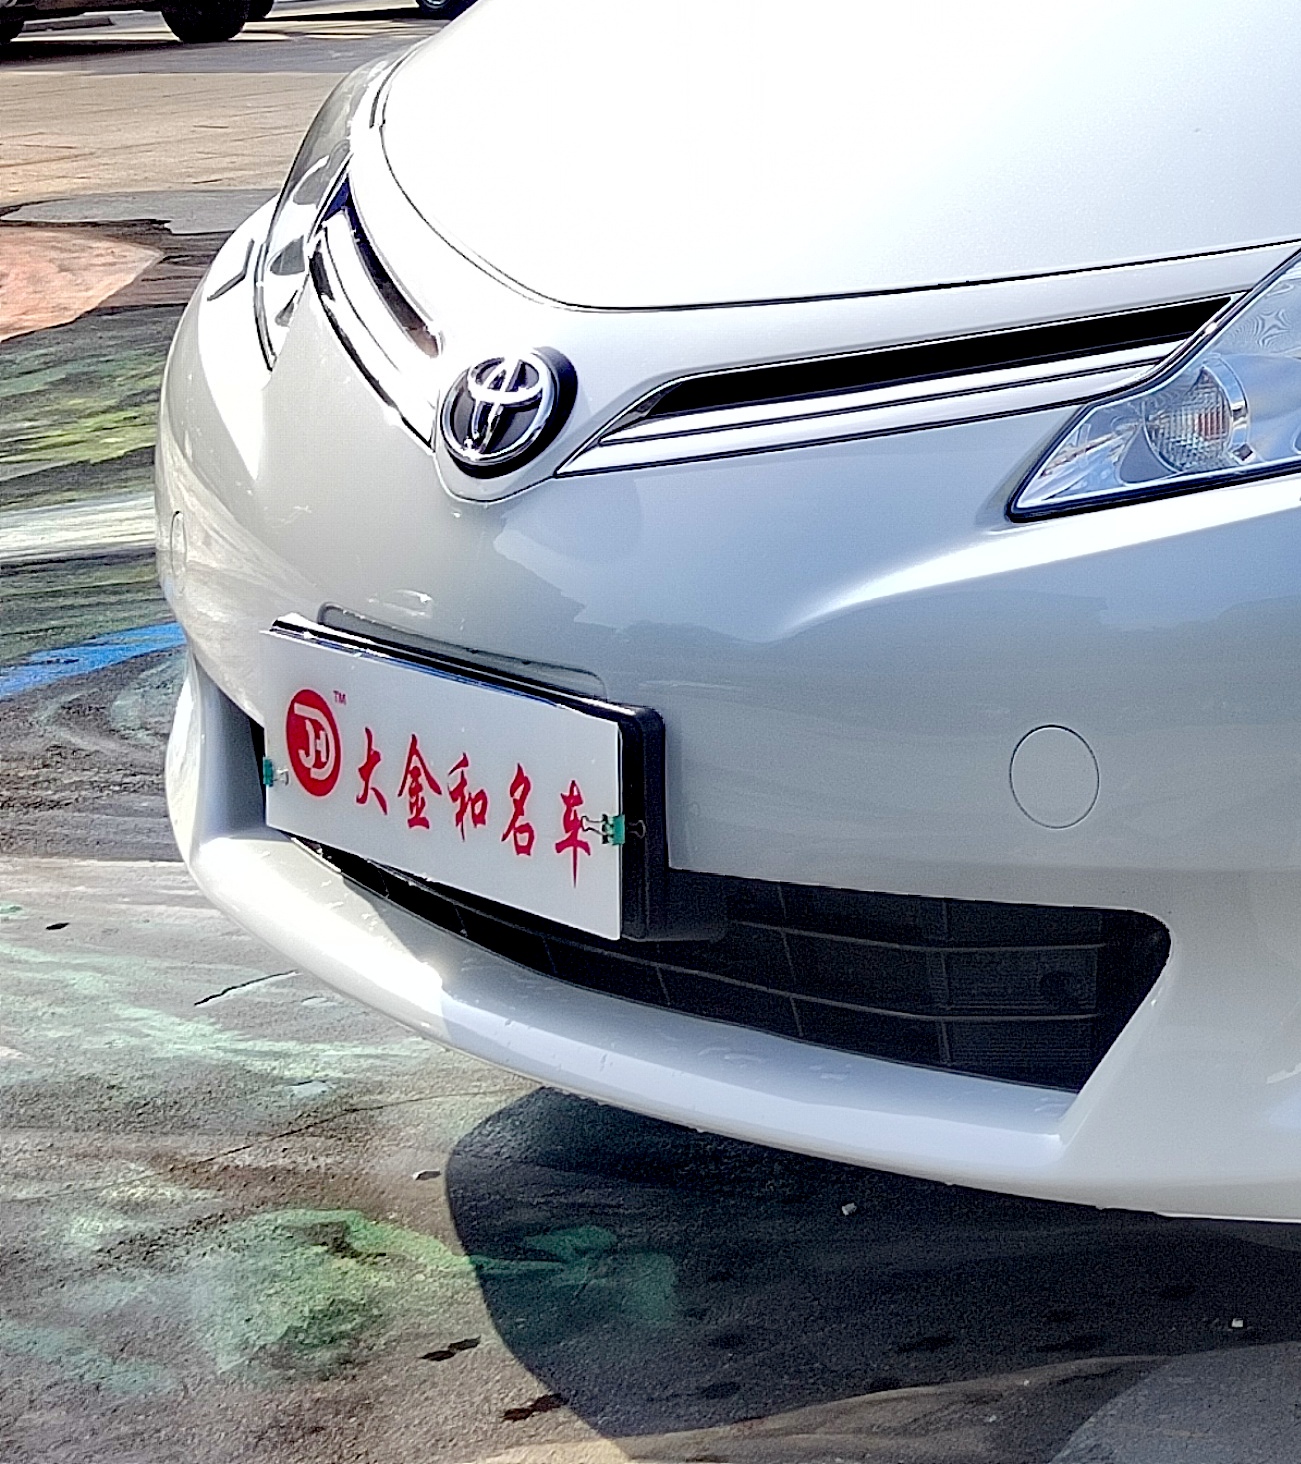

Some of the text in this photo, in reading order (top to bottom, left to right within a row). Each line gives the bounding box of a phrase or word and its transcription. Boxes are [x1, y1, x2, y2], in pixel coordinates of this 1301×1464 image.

[332, 689, 347, 705] TM
[355, 726, 592, 889] 大金和名车
